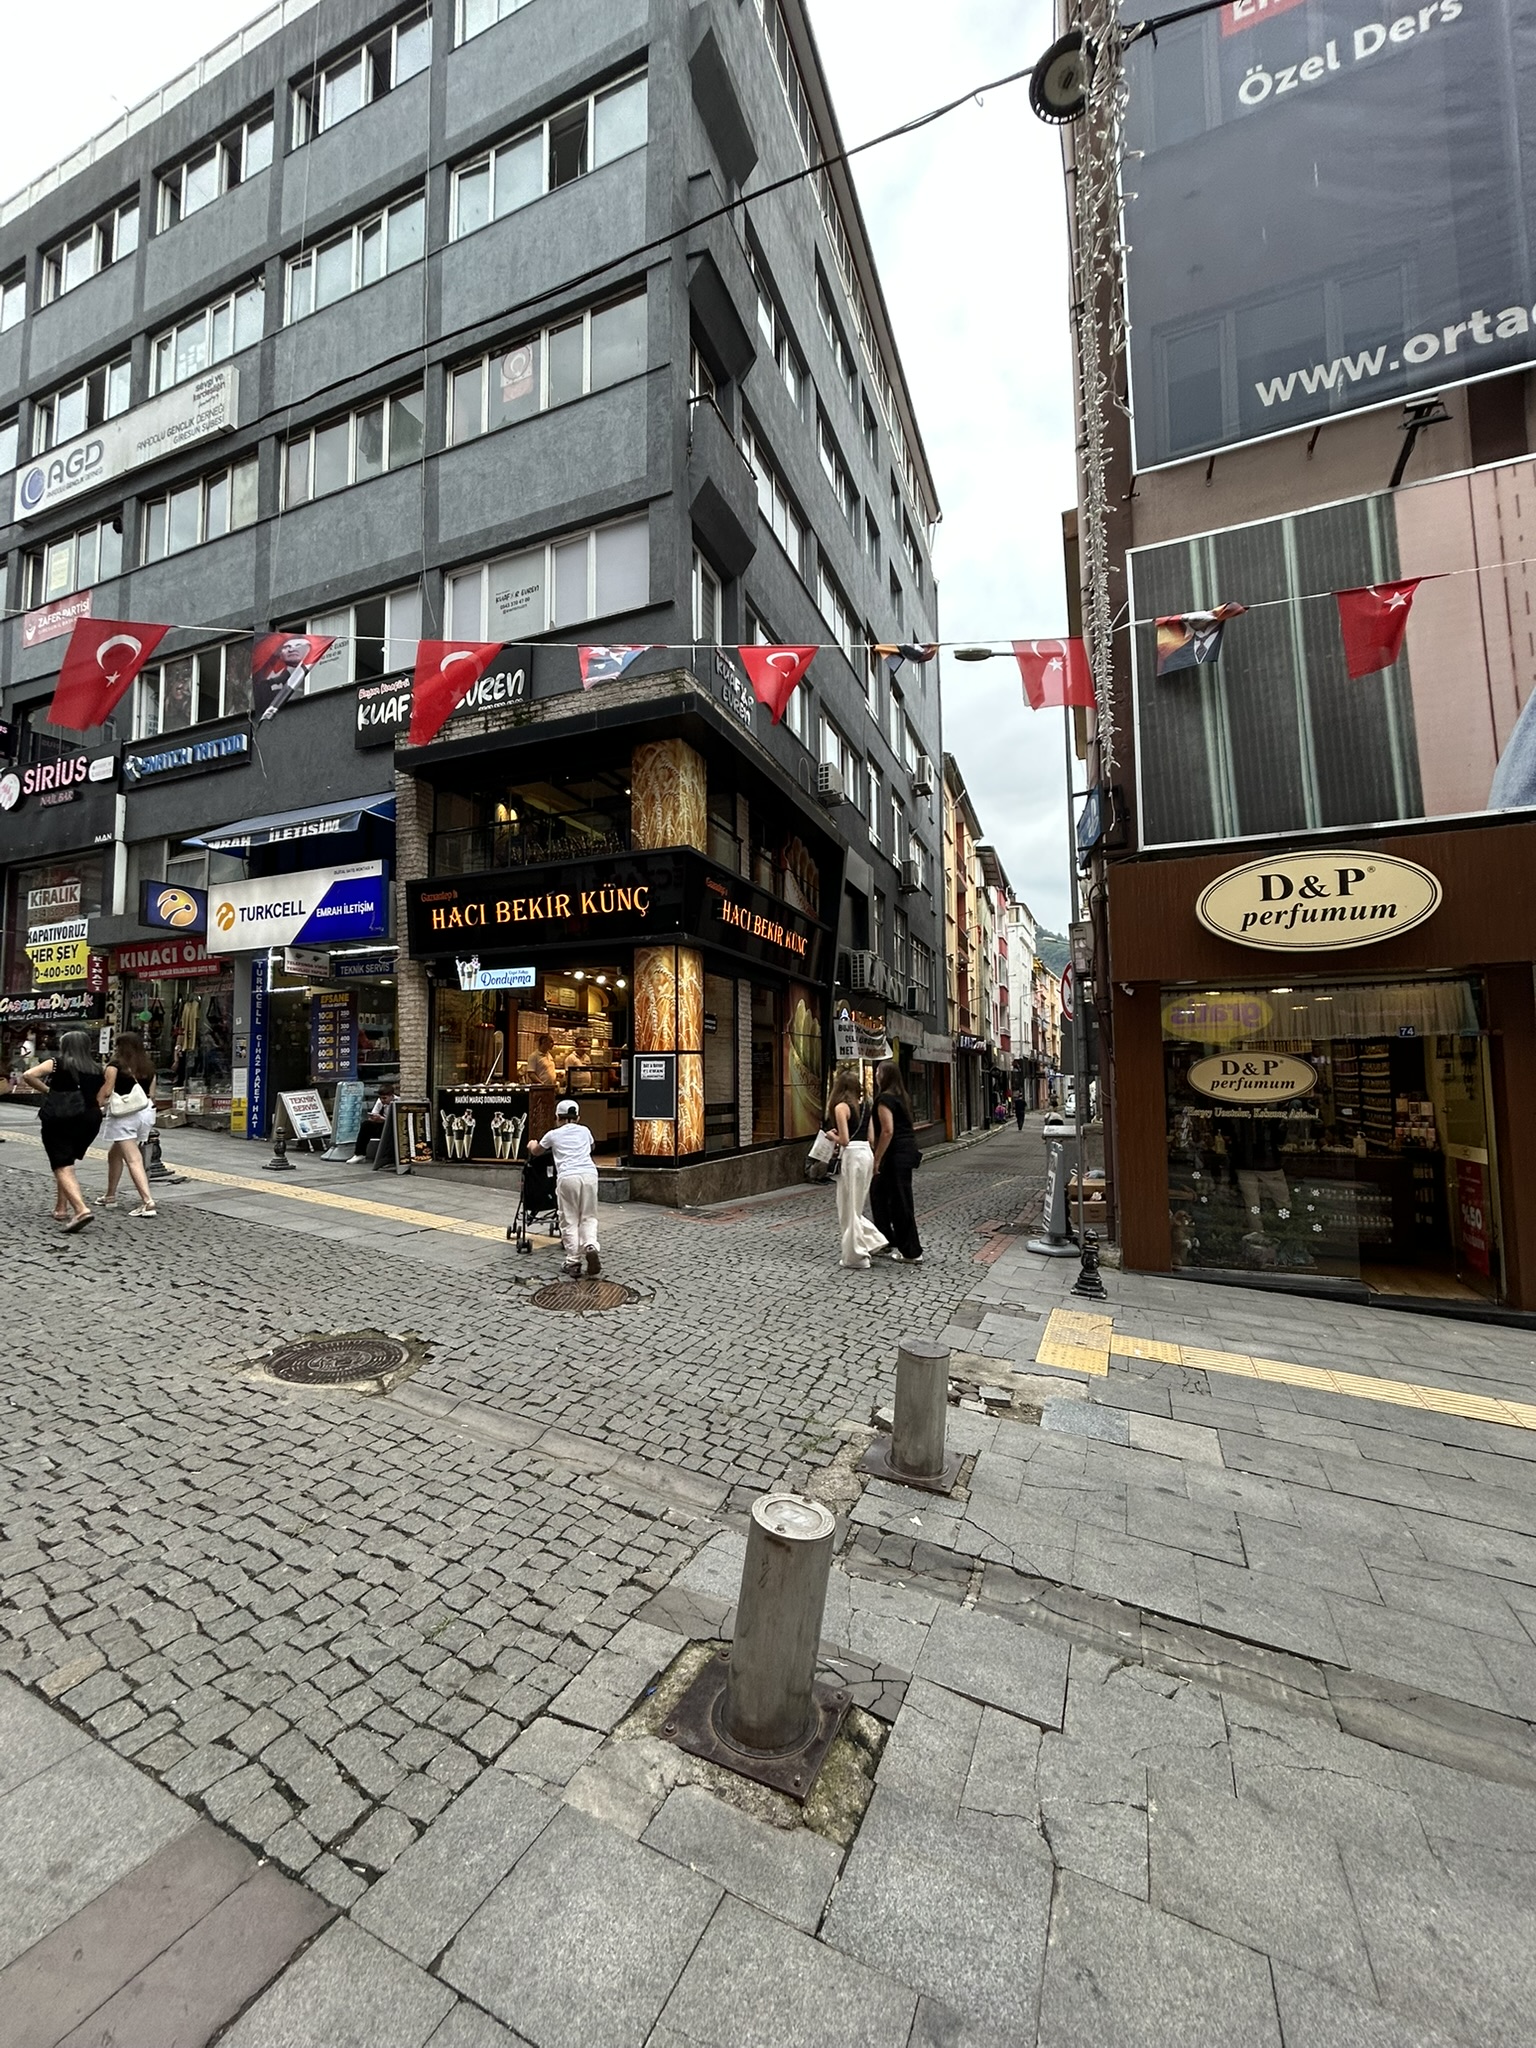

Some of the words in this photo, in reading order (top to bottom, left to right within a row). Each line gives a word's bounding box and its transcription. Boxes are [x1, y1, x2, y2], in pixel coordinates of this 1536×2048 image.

[1238, 40, 1341, 105] Özel
[1353, 0, 1463, 60] Ders
[1255, 305, 1536, 407] www.orta
[47, 439, 105, 490] AGD
[38, 612, 61, 628] ZAFER
[62, 598, 90, 619] PARTİSİ
[141, 747, 193, 776] SNATCH
[193, 733, 248, 762] TATTOO
[23, 755, 88, 795] SİRİUS
[239, 900, 306, 922] TURKCELL
[316, 906, 342, 918] EMRAH
[343, 900, 374, 915] İLETİŞİM
[431, 902, 488, 930] HACI
[495, 892, 572, 924] BEKİR
[580, 883, 650, 917] KÜNÇ
[1240, 902, 1398, 932] perfumum
[27, 923, 86, 944] KAPATIYORUZ
[722, 899, 752, 931] HACI
[753, 915, 784, 946] BEKİR
[31, 947, 54, 963] HER
[56, 944, 79, 963] ŞEY
[120, 946, 178, 969] KINACI
[92, 956, 103, 991] KINACI
[340, 963, 364, 975] TEKNİK
[365, 961, 390, 974] SERVİS
[480, 972, 532, 987] Dondurma
[255, 961, 263, 1025] TURKCELL
[320, 993, 350, 1004] EFSANE
[318, 1011, 334, 1020] 10GB
[318, 1023, 334, 1032] 20GB
[1400, 1027, 1415, 1036] 74
[318, 1048, 334, 1057] 60GB
[318, 1061, 334, 1070] 90GB
[254, 1068, 262, 1103] PAKET
[1210, 1077, 1296, 1091] perfumum
[288, 1095, 317, 1104] TEKNİK
[292, 1103, 319, 1112] SERVİS
[251, 1105, 259, 1128] HAT
